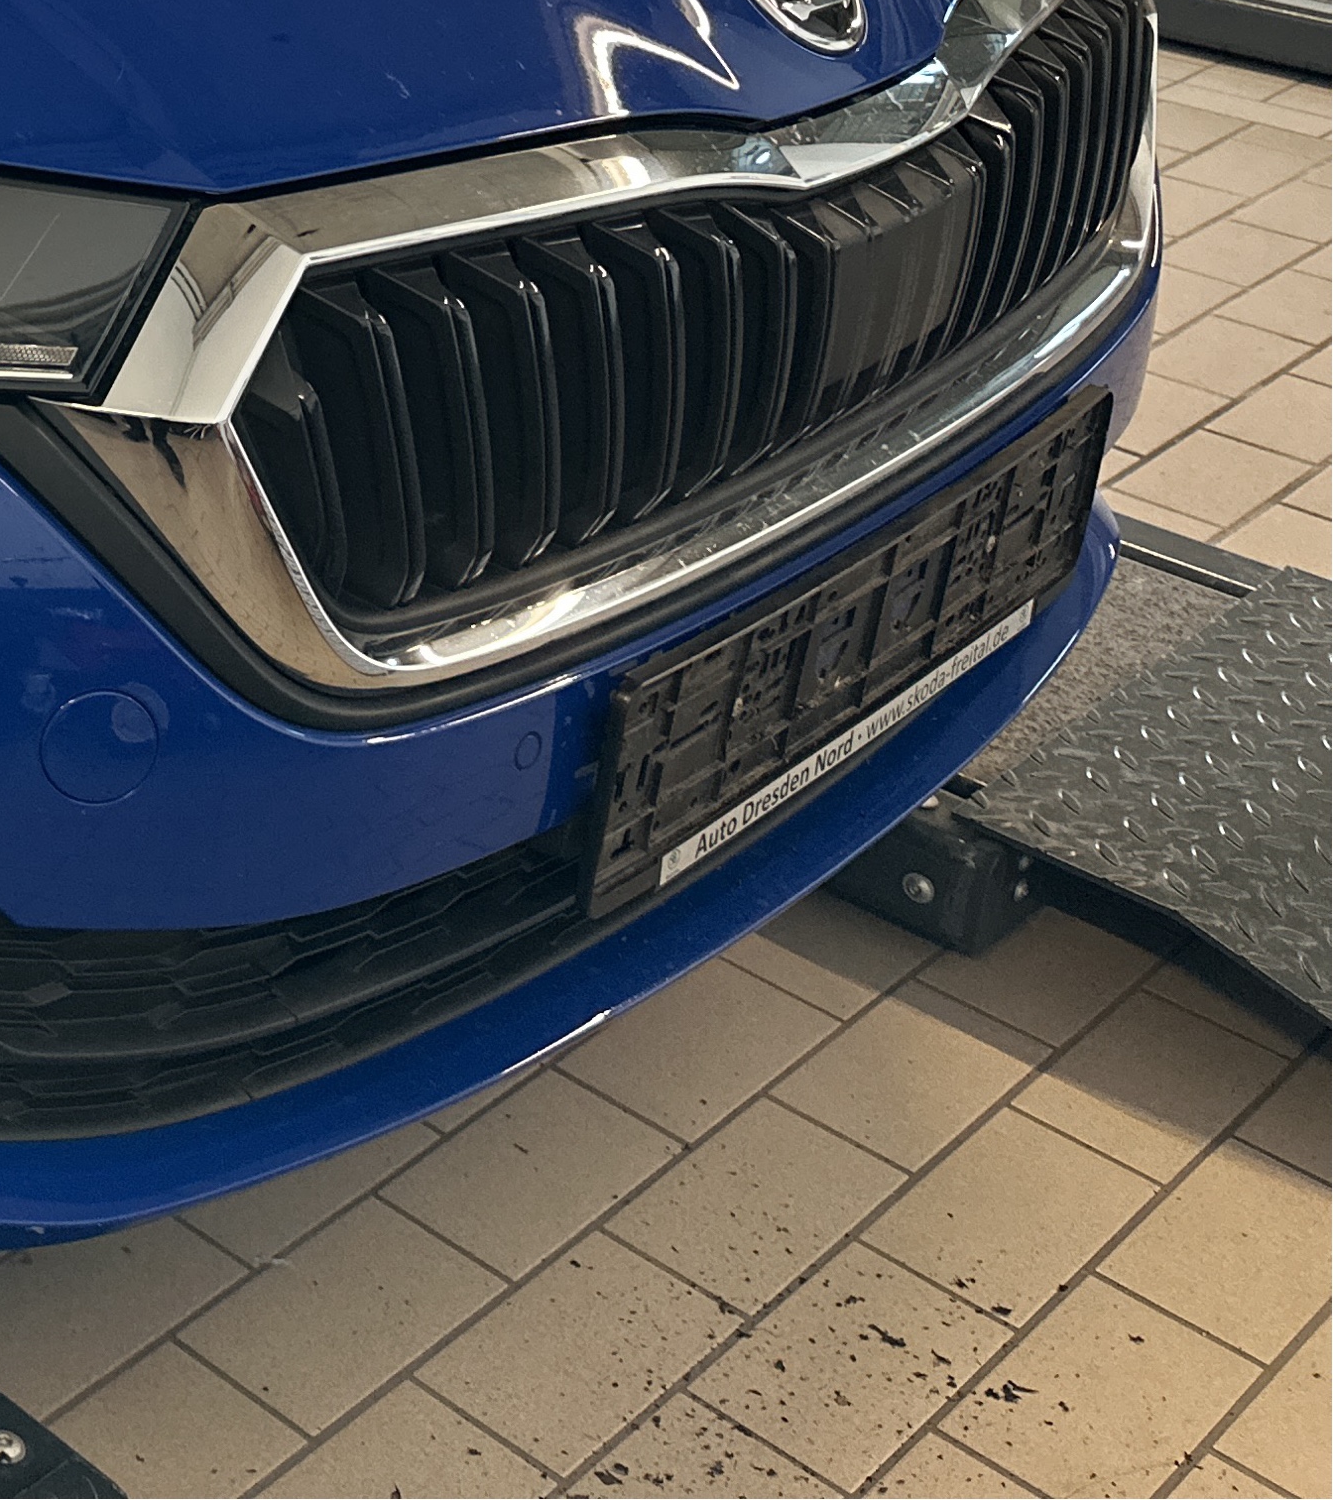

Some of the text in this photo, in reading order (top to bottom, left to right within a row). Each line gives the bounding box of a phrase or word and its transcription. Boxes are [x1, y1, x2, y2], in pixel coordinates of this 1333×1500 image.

[694, 623, 1010, 859] Auto Dresden Nord www.skoda-freital.de
